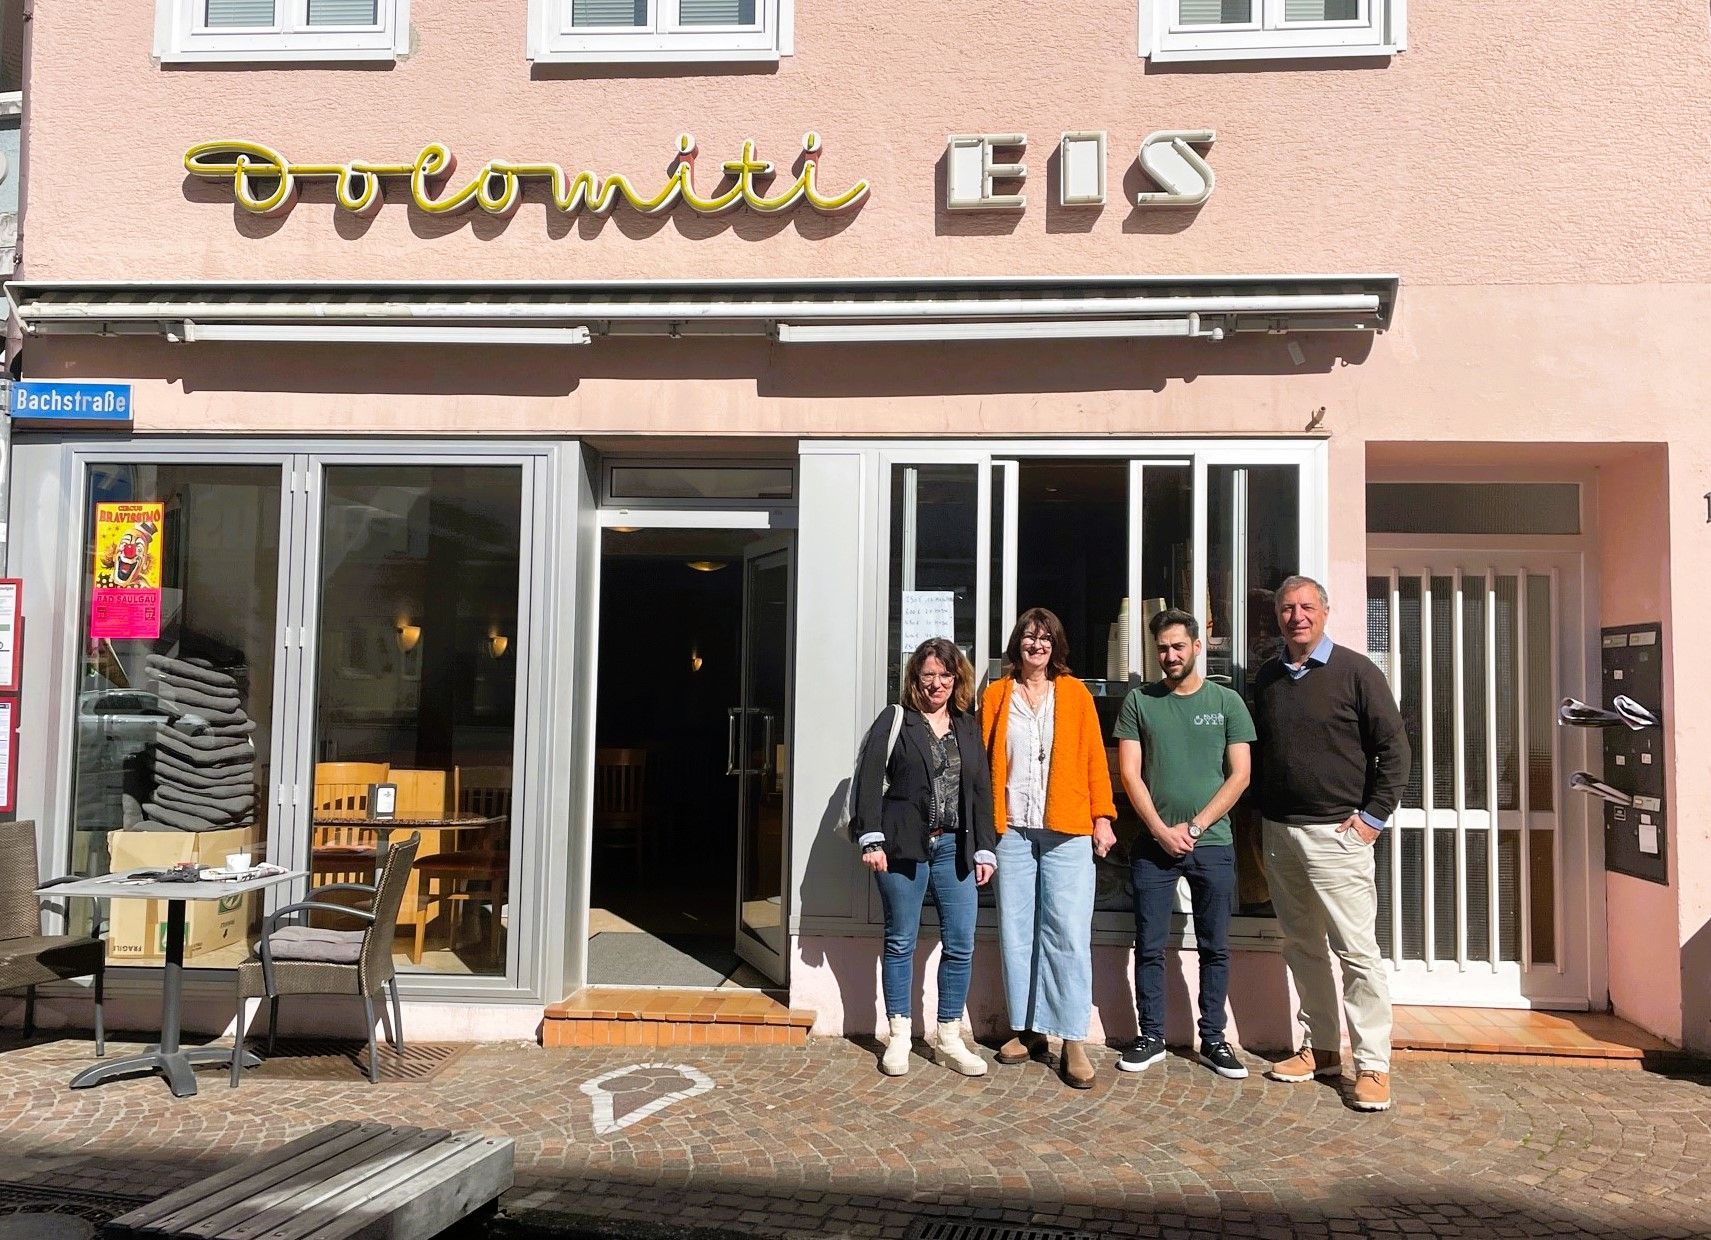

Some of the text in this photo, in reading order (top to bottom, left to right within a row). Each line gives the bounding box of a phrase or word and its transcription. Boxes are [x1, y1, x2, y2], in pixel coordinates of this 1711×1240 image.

[183, 129, 1217, 214] Dolomiti EIS
[16, 388, 126, 413] Bachstraße
[97, 595, 156, 604] BAD SAULGAU
